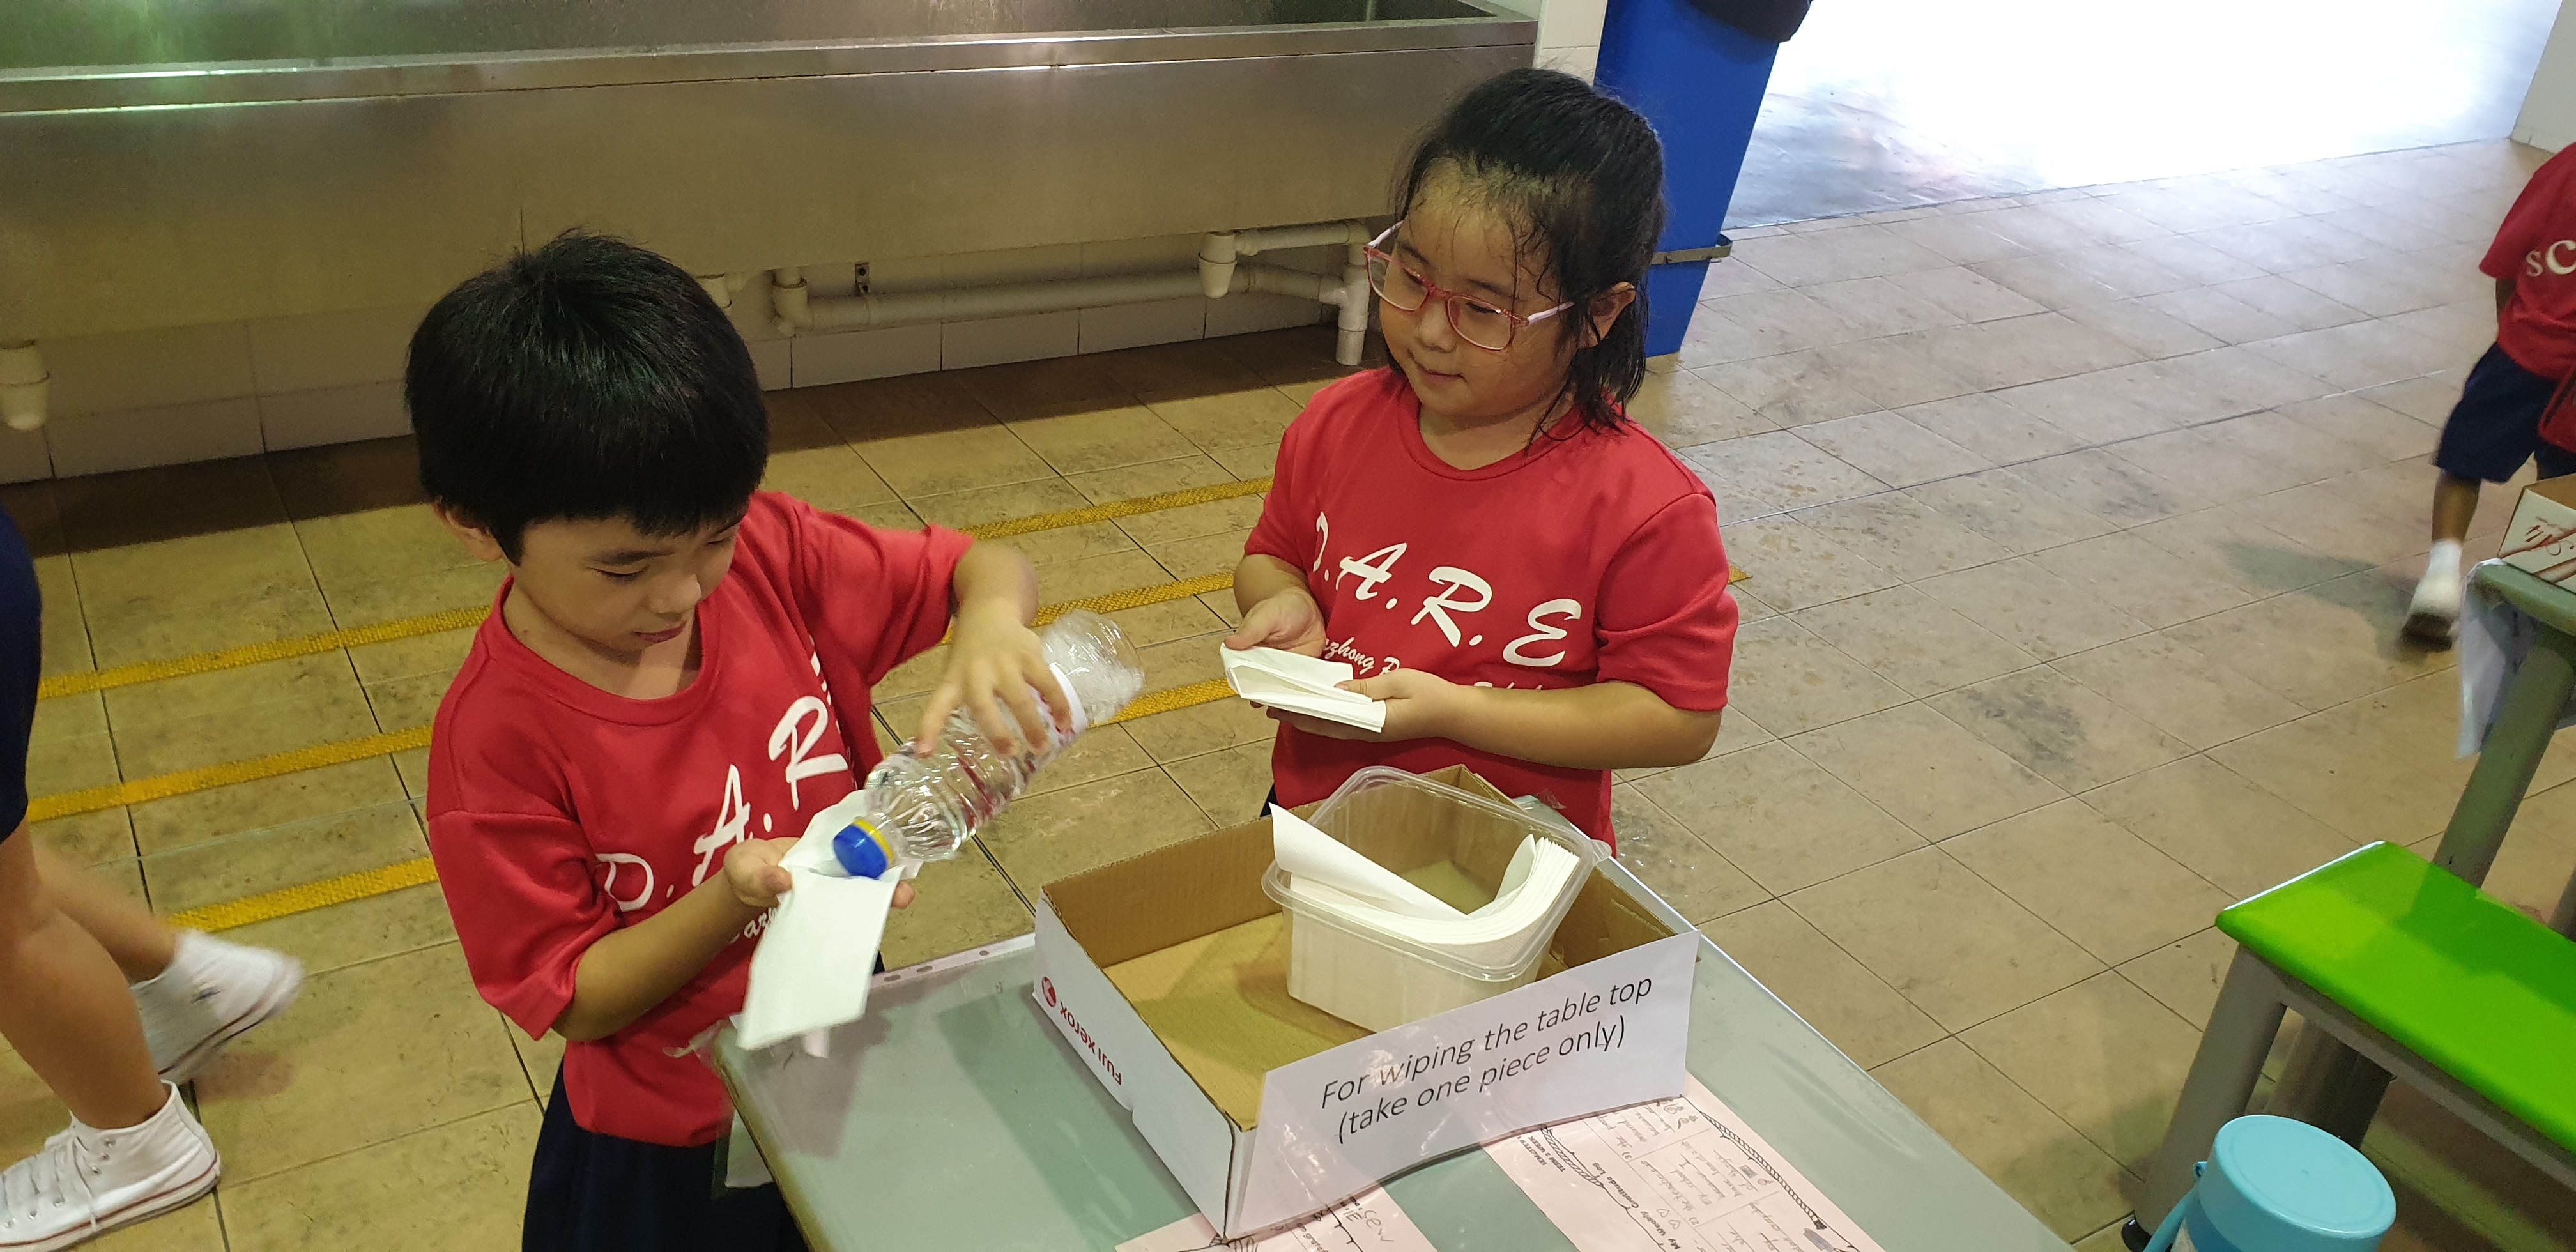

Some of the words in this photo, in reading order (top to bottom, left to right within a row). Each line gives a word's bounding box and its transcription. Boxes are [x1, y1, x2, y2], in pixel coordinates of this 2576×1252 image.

[1321, 1074, 1370, 1109] For
[1379, 1038, 1475, 1085] wiping
[1484, 1020, 1528, 1051] the
[1537, 991, 1600, 1032] table
[1609, 977, 1652, 1006] top
[1338, 1096, 1408, 1144] (take
[1417, 1074, 1471, 1107] one
[1479, 1044, 1551, 1092] piece
[1558, 1014, 1627, 1057] only)
[1528, 1136, 1546, 1153] WEEK
[1548, 1157, 1566, 1172] TERM
[1591, 1163, 1607, 1175] Log
[1607, 1176, 1639, 1209] Gratitude
[1667, 1238, 1682, 1250] My
